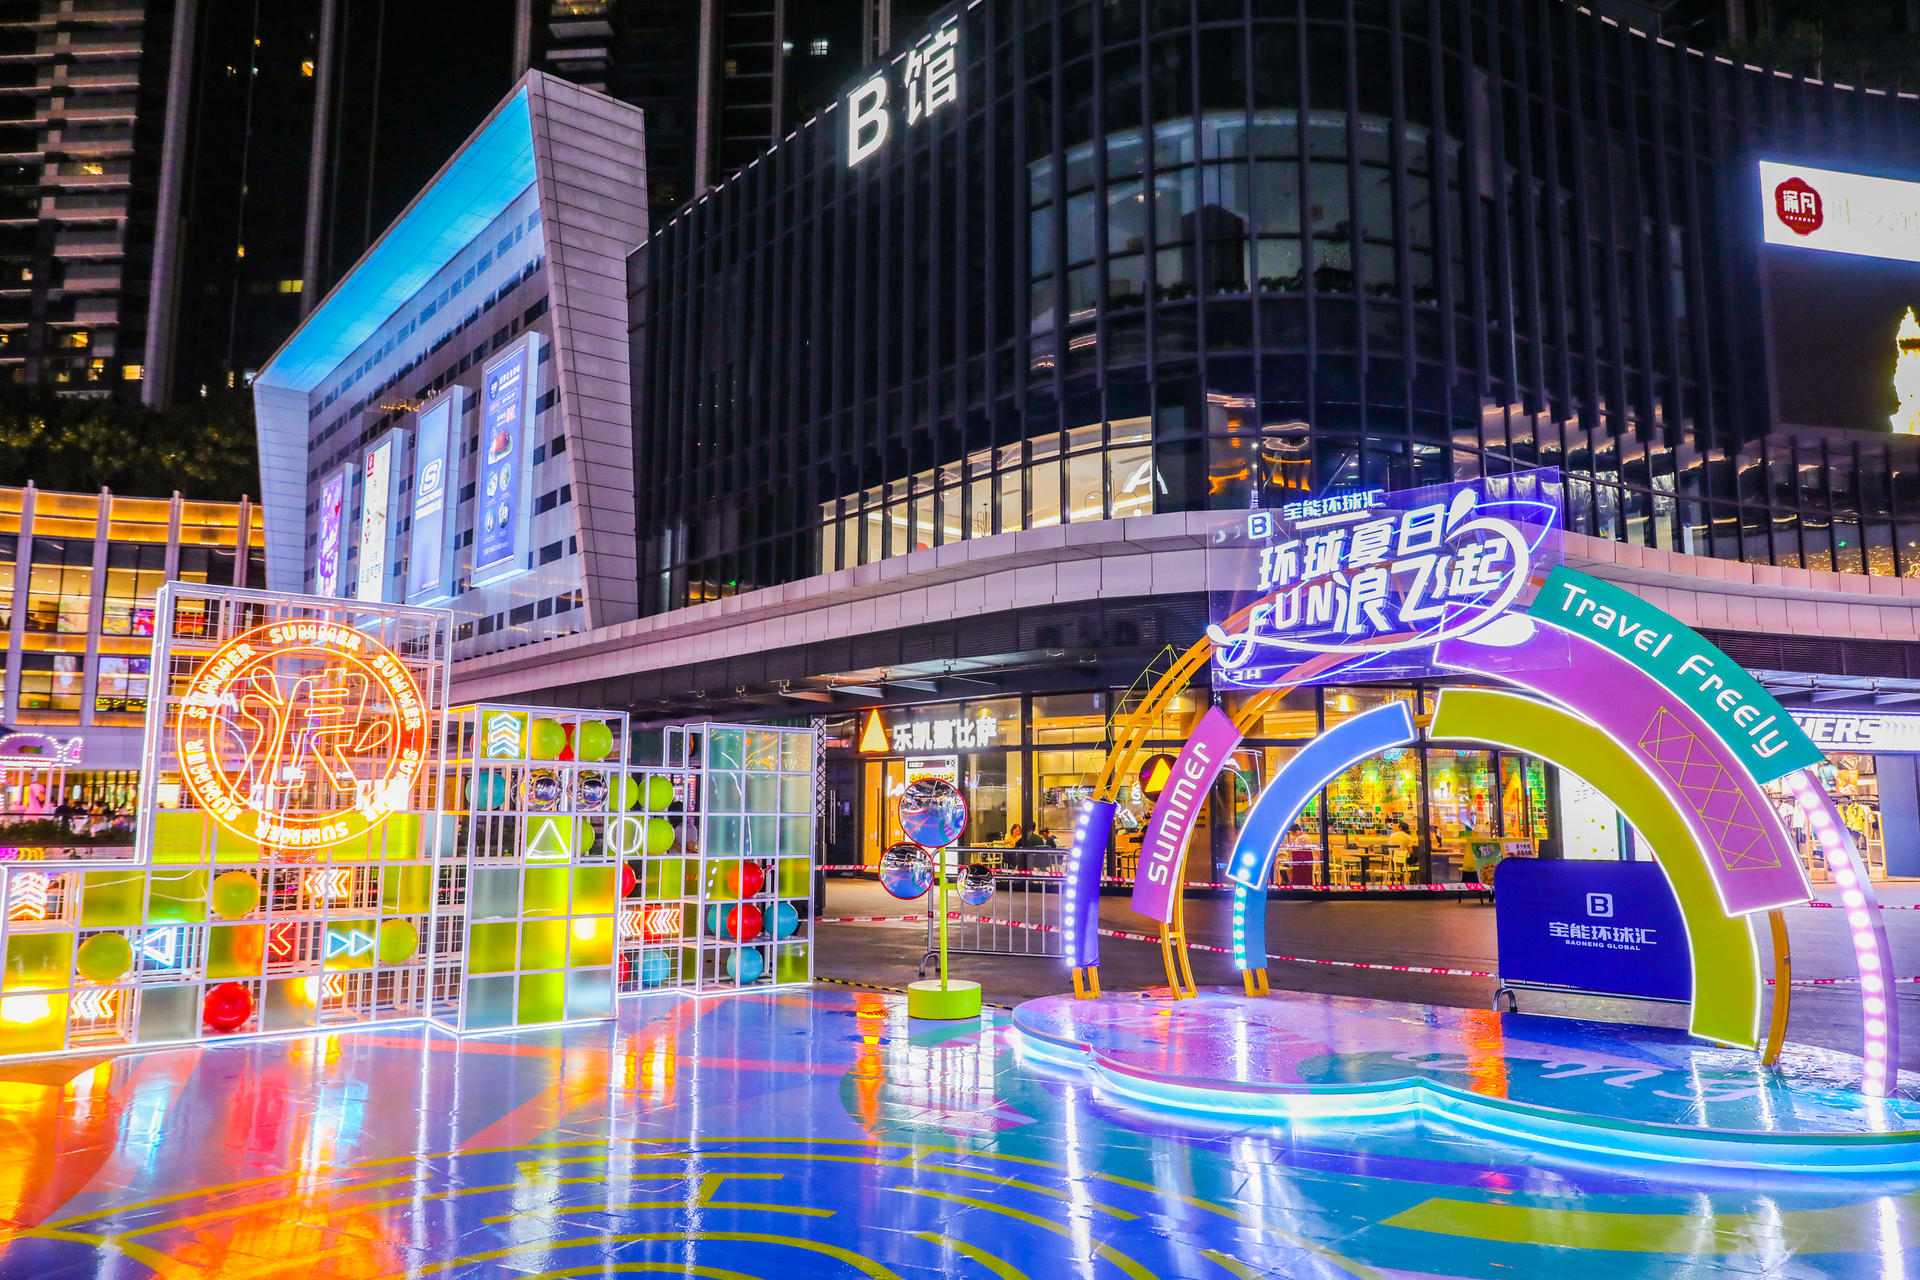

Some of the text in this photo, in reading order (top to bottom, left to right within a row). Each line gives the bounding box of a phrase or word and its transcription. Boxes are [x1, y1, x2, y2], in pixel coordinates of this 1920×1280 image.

[849, 27, 958, 168] B馆
[1283, 489, 1386, 521] 宝能环球汇
[1250, 513, 1271, 538] B
[1257, 503, 1448, 592] 环球夏日
[269, 624, 362, 651] SUMMER
[1562, 582, 1789, 759] Travel Freely
[372, 655, 421, 731] SUMMER
[185, 739, 243, 822] SUMMER
[1588, 894, 1611, 916] B
[1549, 921, 1657, 944] 宝能环球汇
[1565, 939, 1641, 951] BAONENG GLOBAL
